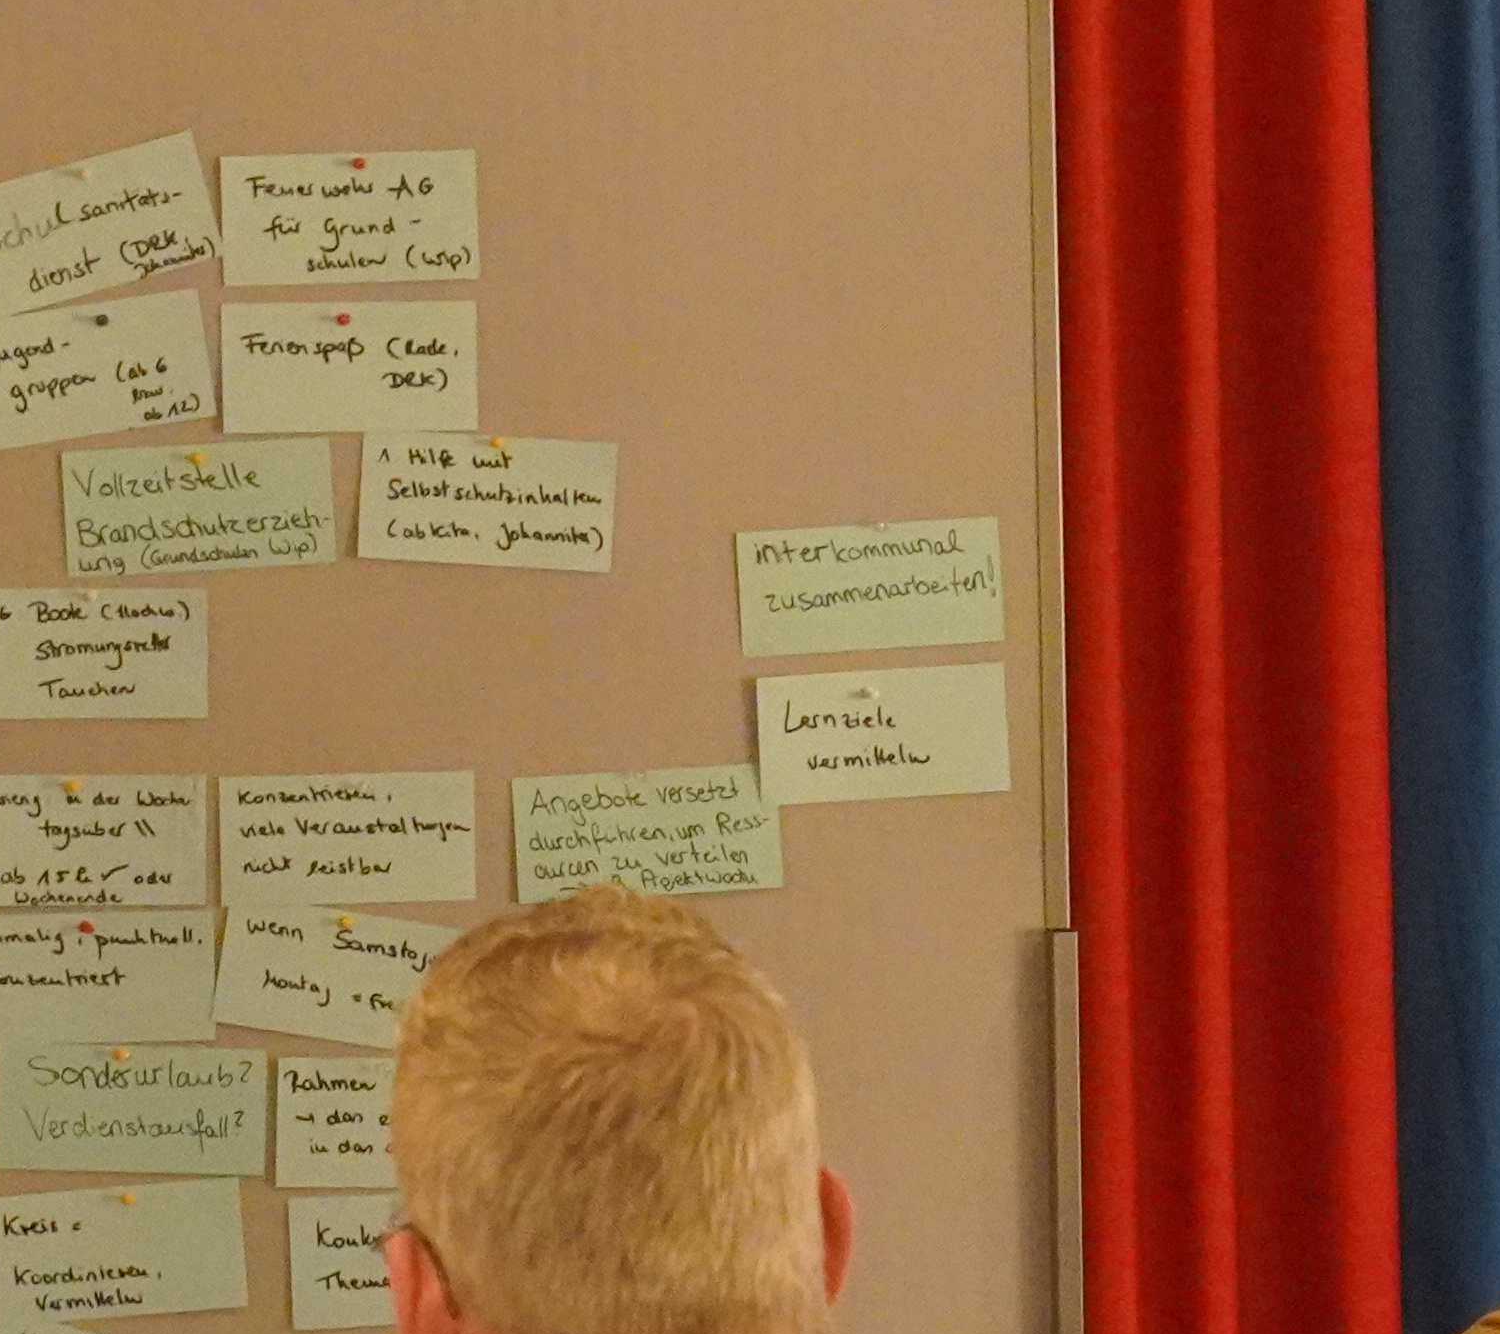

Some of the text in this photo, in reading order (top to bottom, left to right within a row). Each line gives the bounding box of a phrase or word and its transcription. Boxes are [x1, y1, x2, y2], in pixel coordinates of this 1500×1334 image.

[263, 215, 301, 241] für
[37, 677, 136, 699] Tauchen
[784, 699, 897, 734] Lernziele
[529, 784, 648, 826] Angebote
